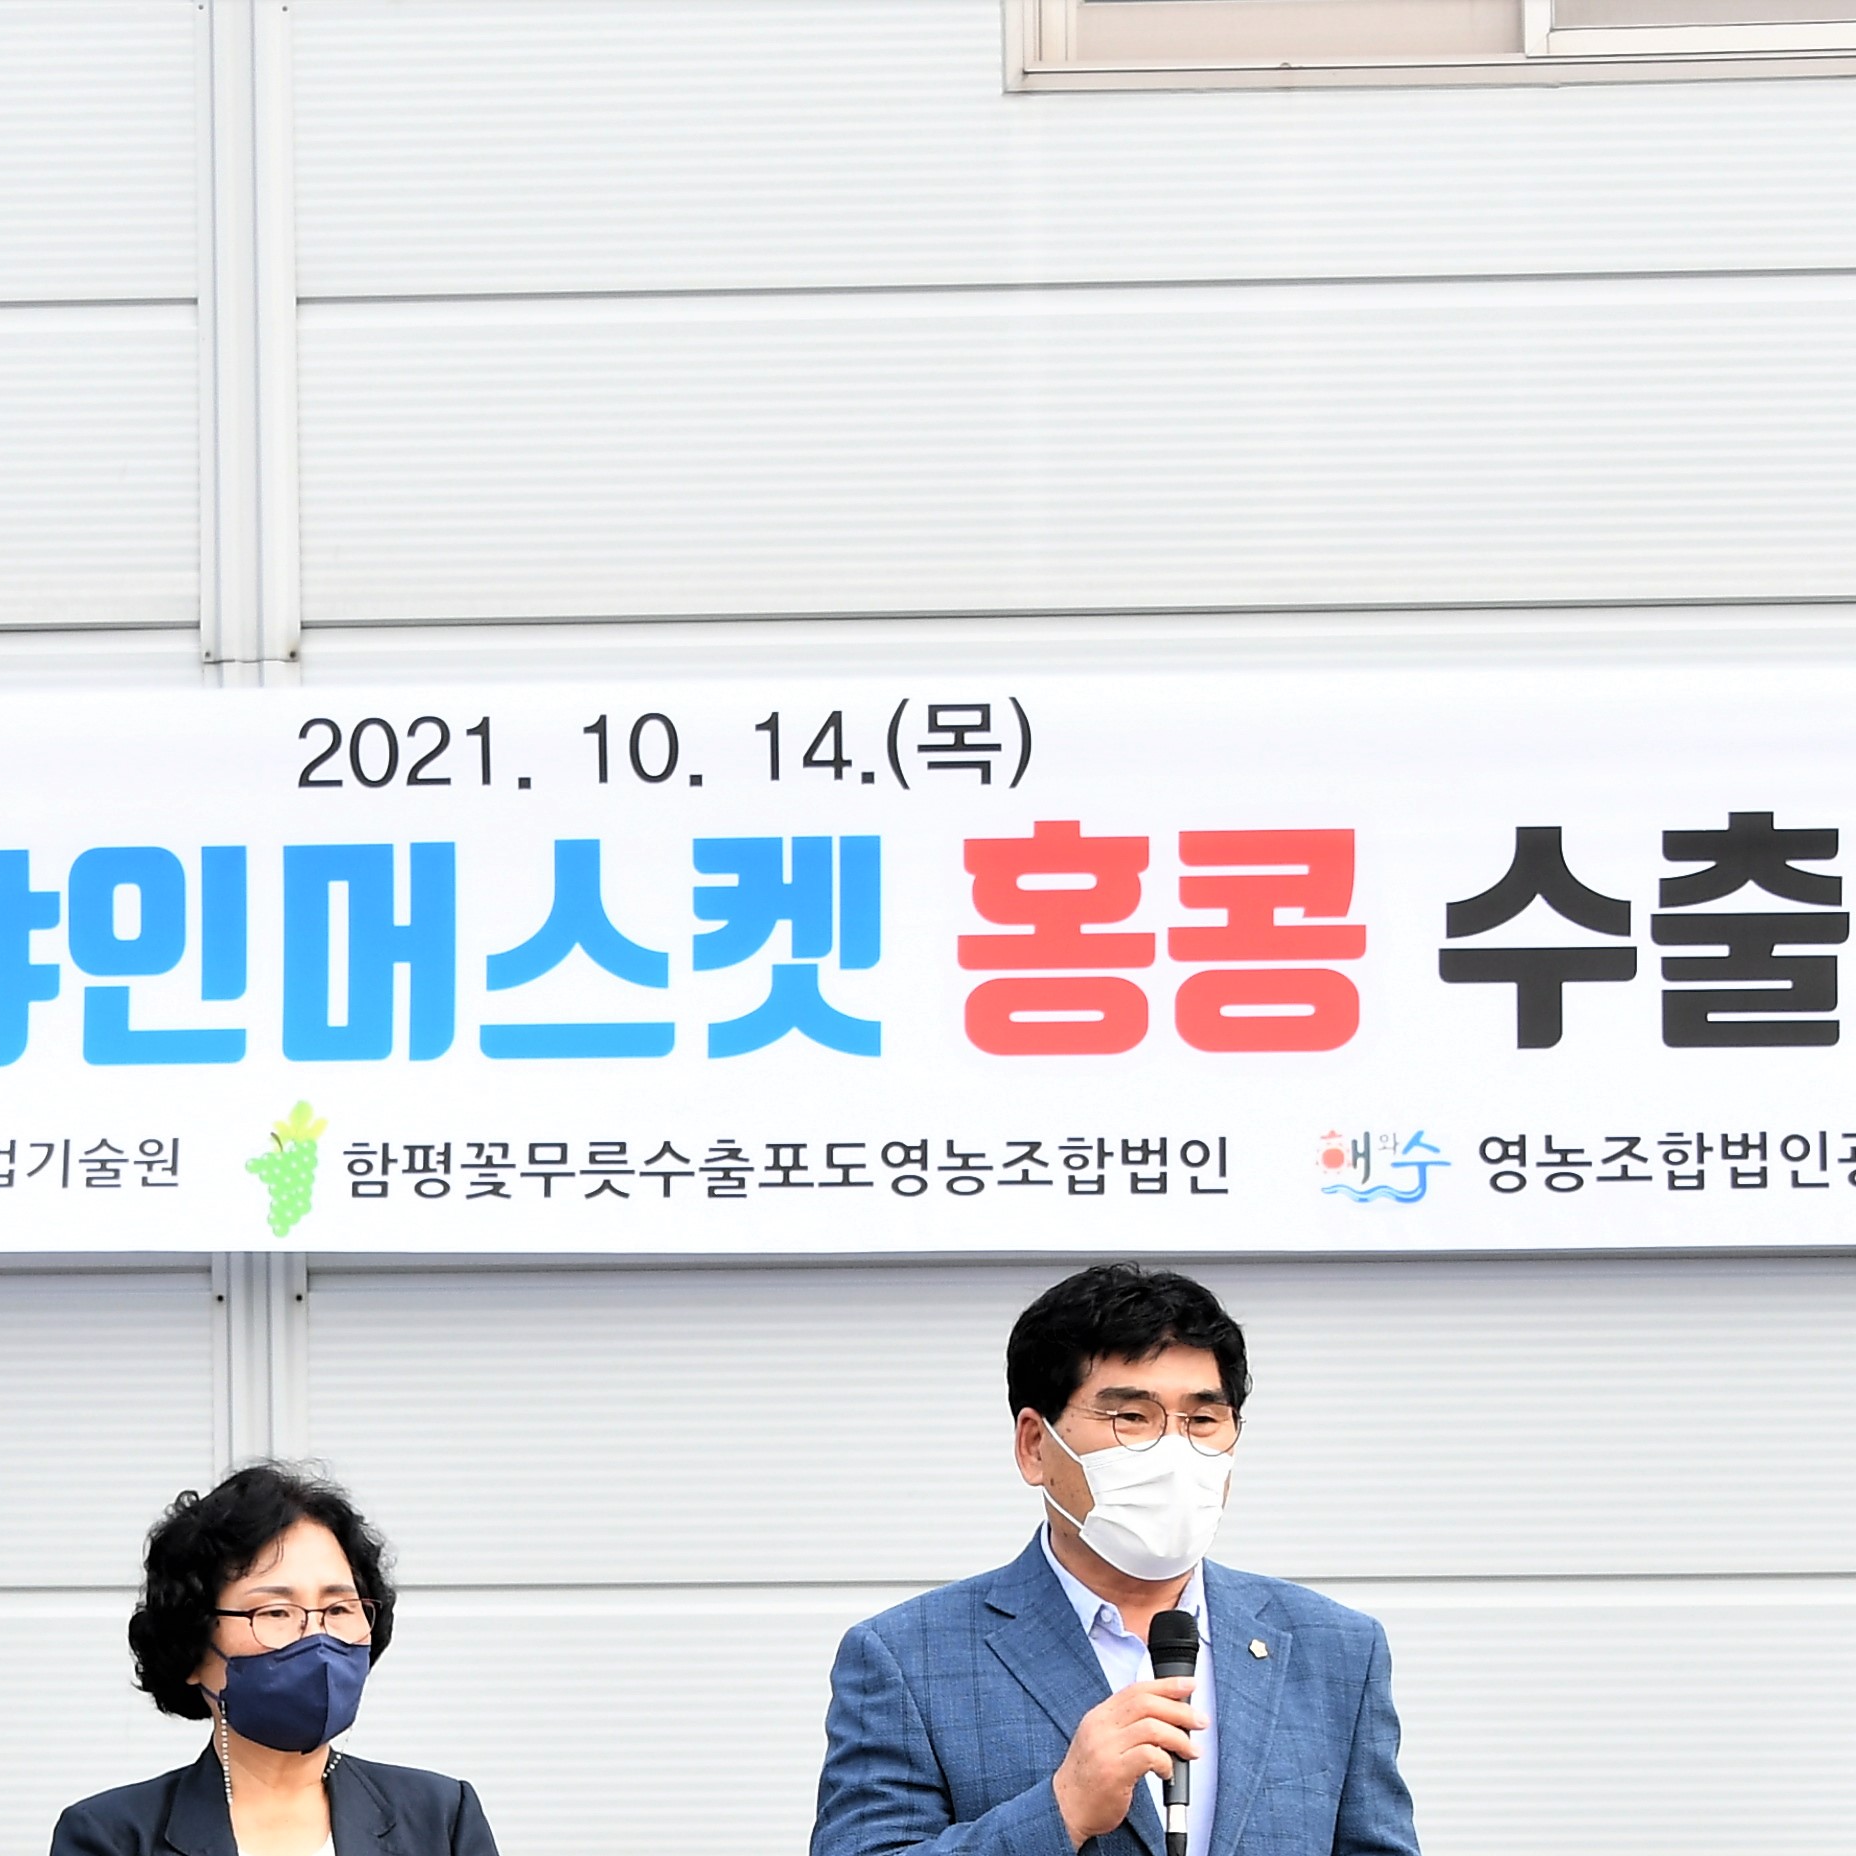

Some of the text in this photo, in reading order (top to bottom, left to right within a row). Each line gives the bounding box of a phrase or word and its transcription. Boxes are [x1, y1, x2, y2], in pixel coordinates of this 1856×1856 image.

[298, 697, 1031, 790] 2021. 10. 14.(목)
[958, 820, 1366, 1056] 홍콩
[1438, 811, 1850, 1049] 수출
[343, 1136, 1229, 1199] 함평꽃무릇수출포도영농조합법인
